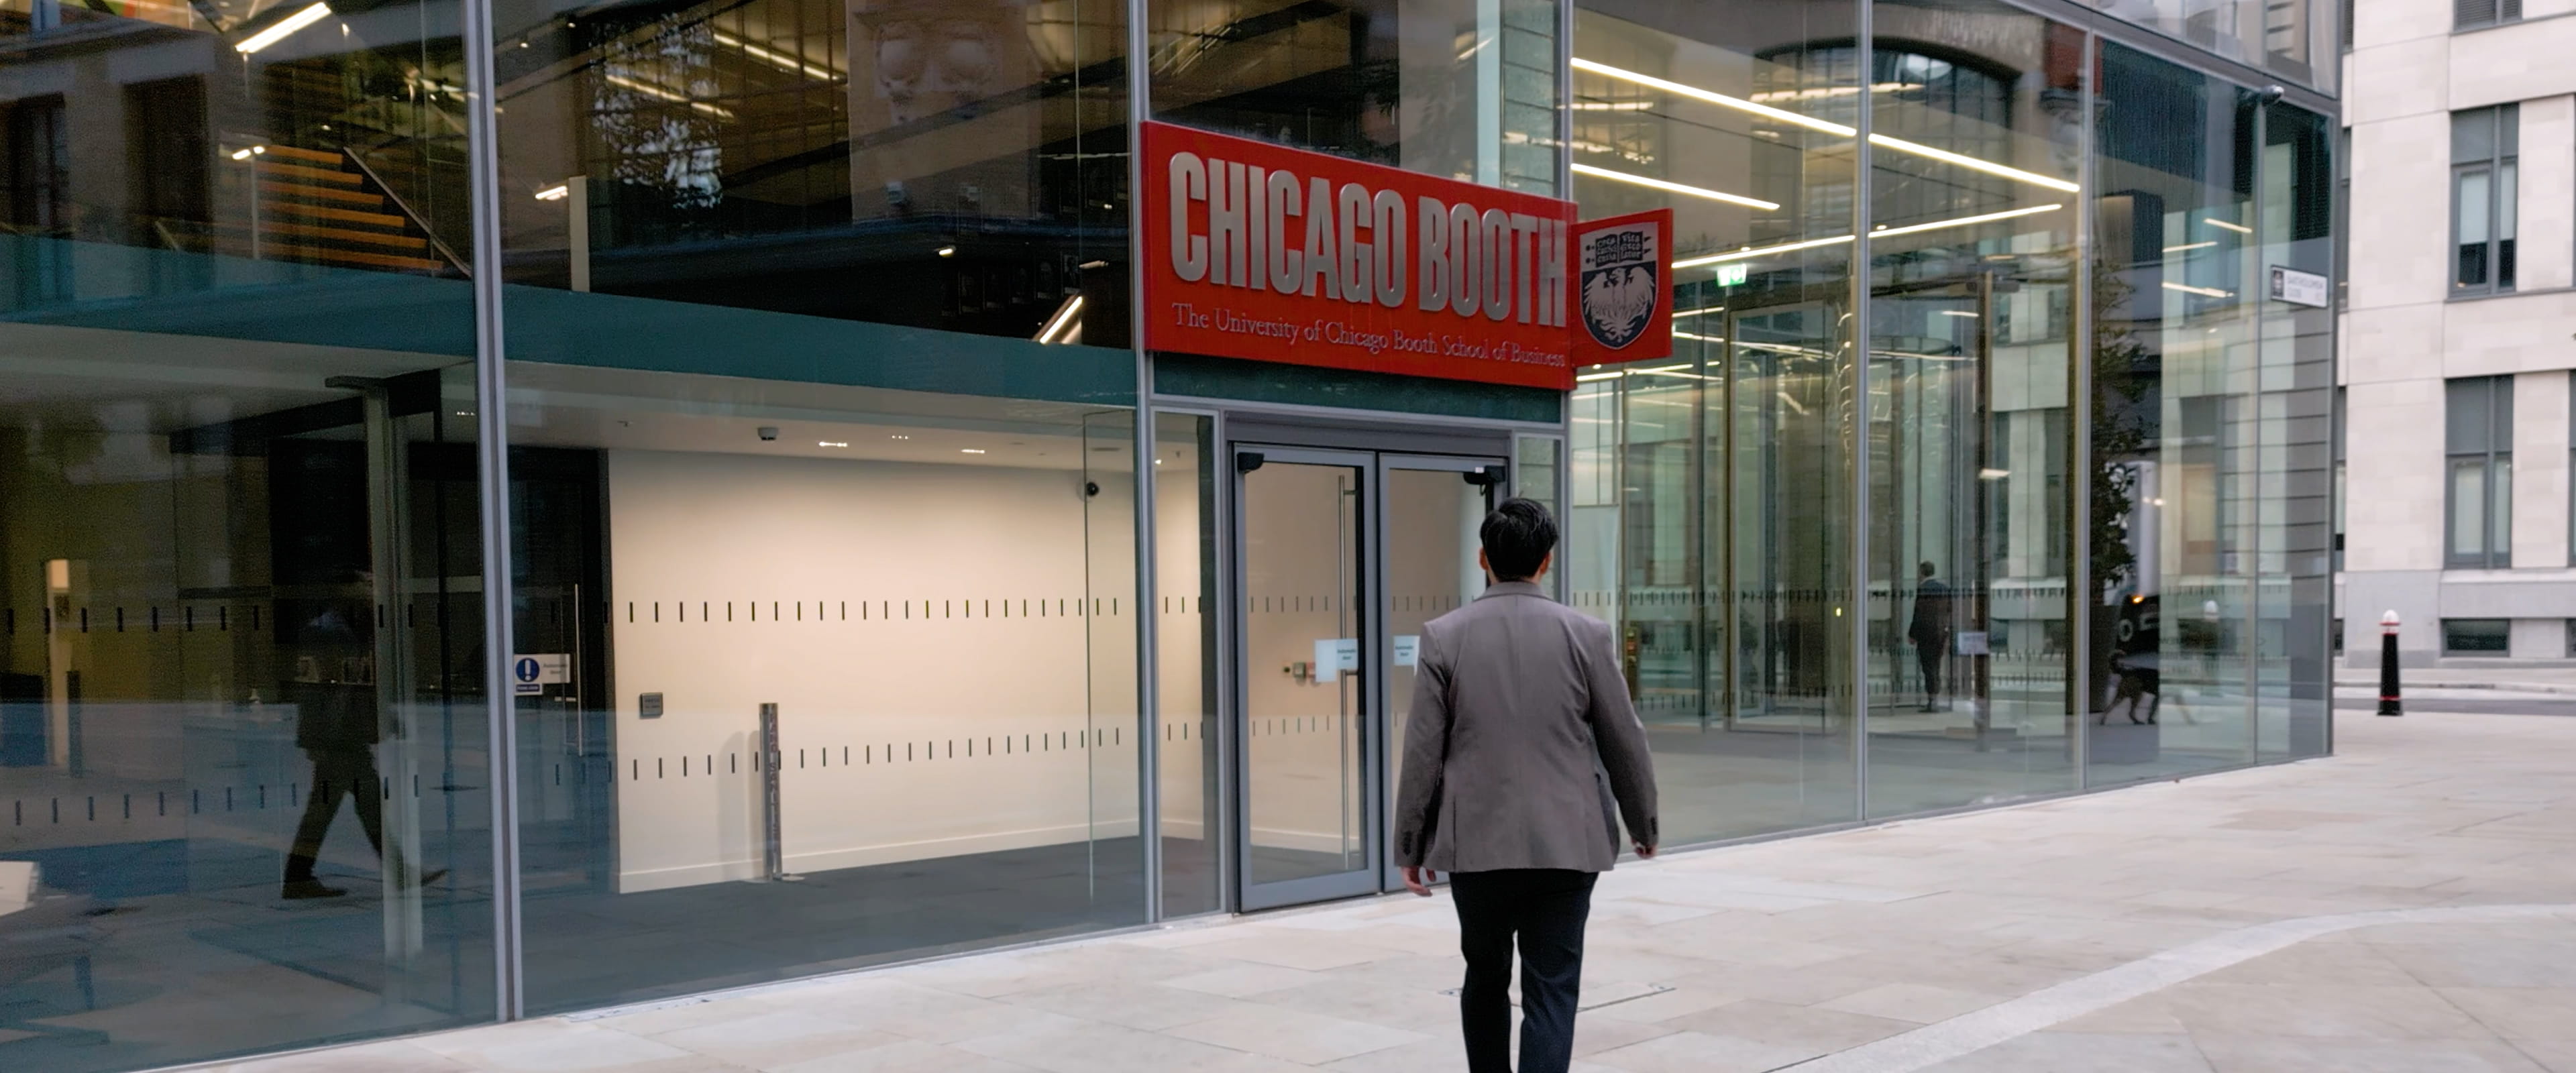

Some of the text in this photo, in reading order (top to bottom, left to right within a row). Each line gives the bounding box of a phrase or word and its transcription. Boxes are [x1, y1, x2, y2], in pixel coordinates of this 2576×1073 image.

[1169, 151, 1567, 328] CHICAGO BOOTH
[1172, 302, 1566, 368] The University of Chicago Booth School of Business
